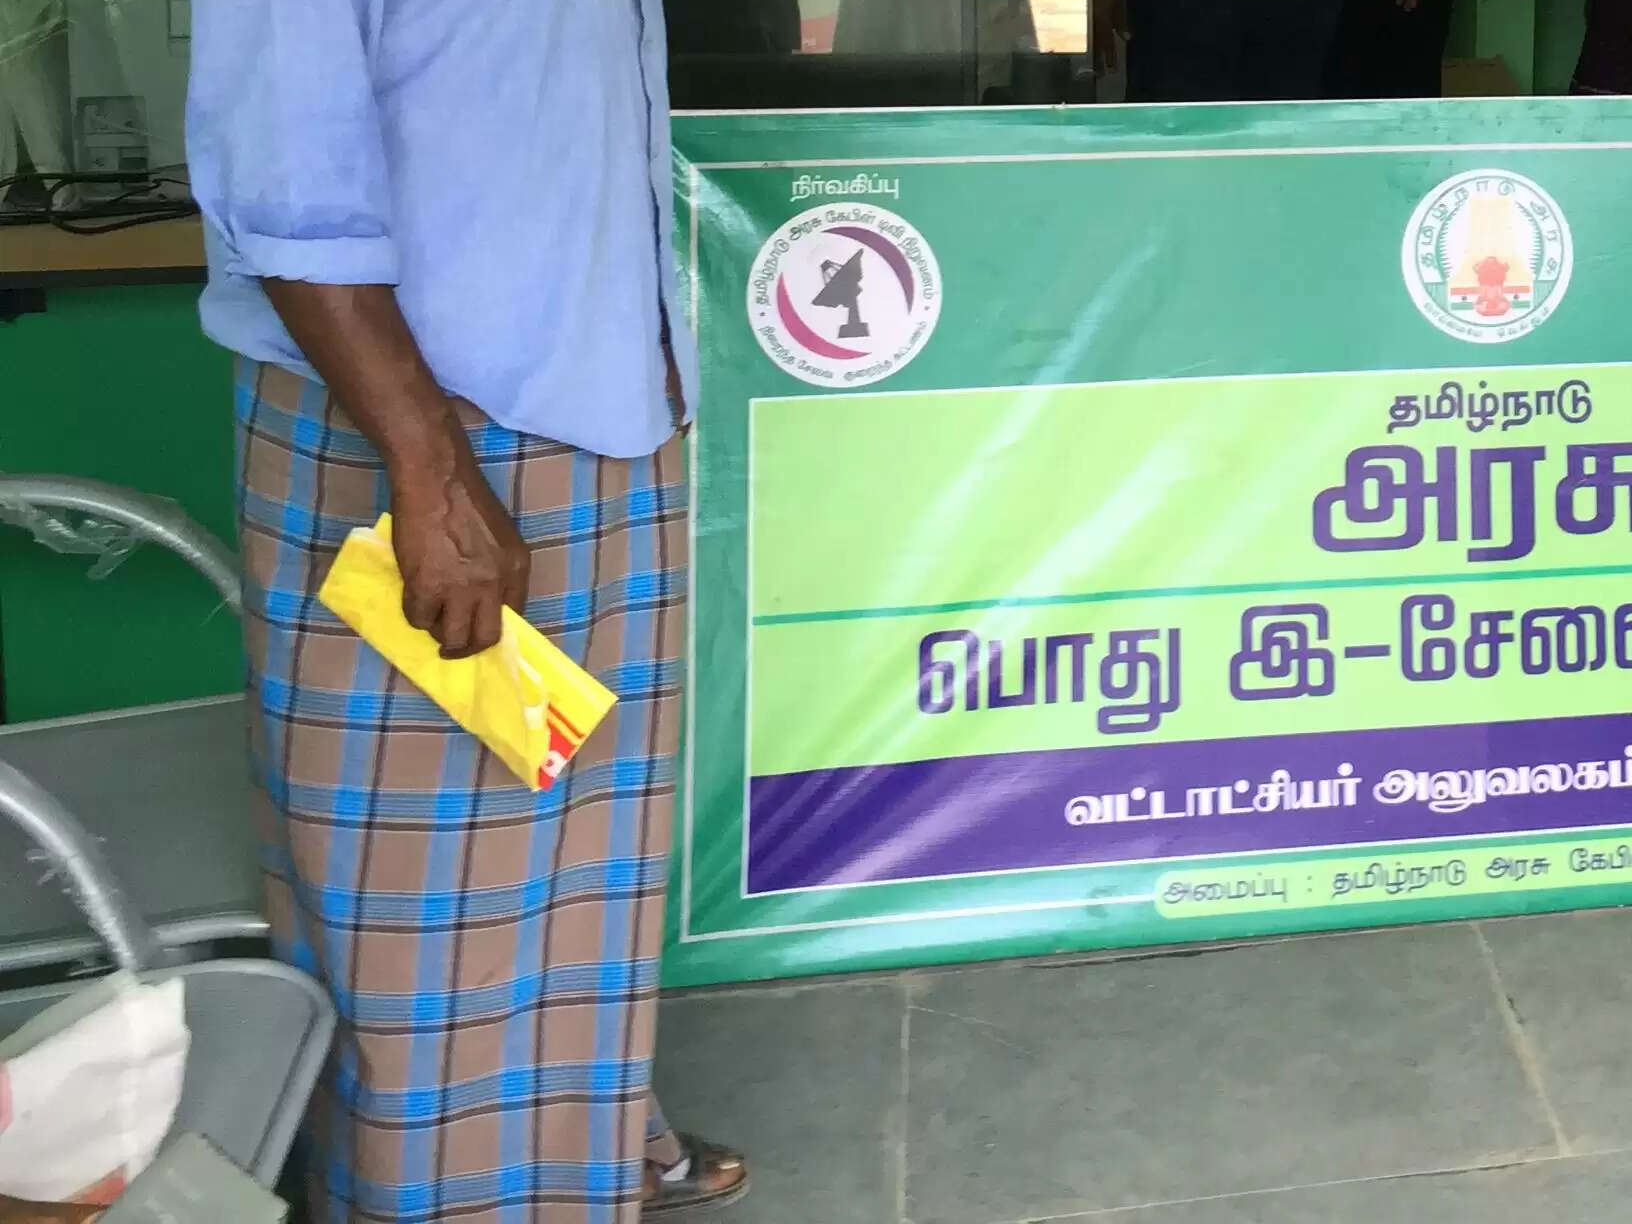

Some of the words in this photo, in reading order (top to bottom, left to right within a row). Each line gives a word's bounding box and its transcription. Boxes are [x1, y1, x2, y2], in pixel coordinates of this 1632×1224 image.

[791, 173, 899, 203] நிர்வகிப்பு
[1387, 380, 1592, 433] தமிழ்நாடு
[918, 628, 1180, 734] பொது
[1065, 763, 1361, 825] வட்டாட்சியர்
[1163, 872, 1288, 906] அமைப்பு
[1330, 857, 1468, 900] தமிழ்நாடு
[1484, 855, 1552, 883] அரசு
